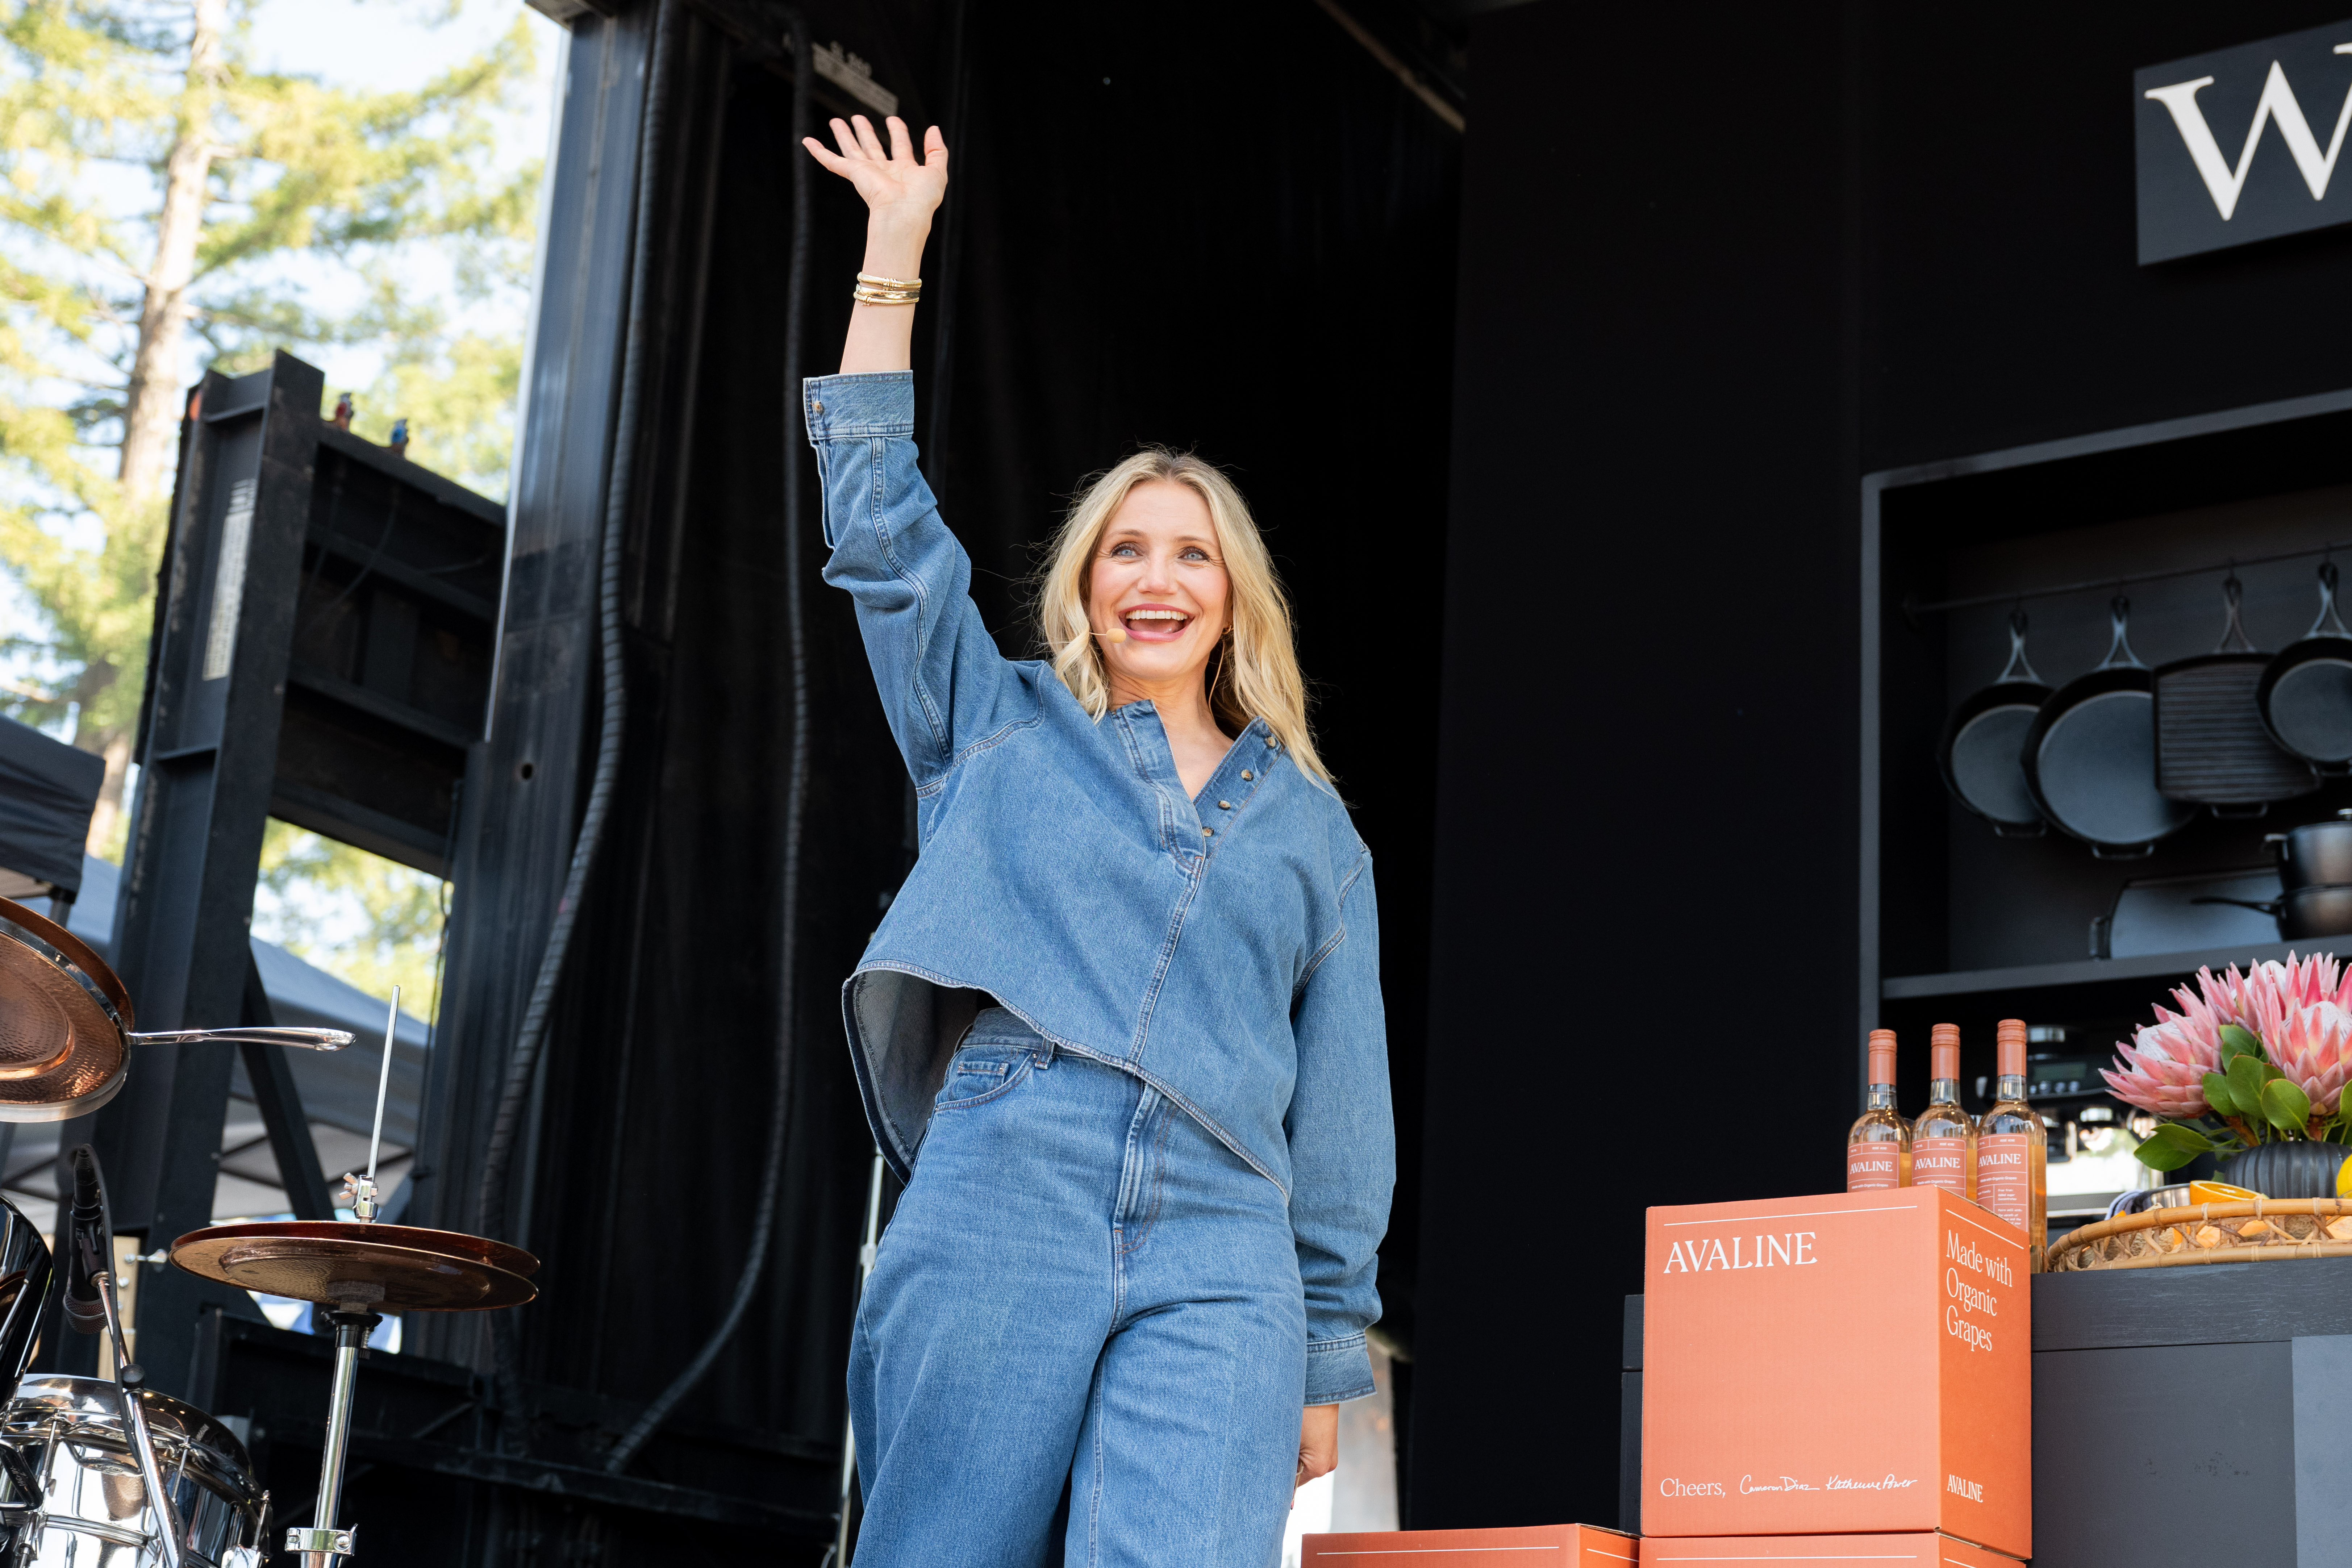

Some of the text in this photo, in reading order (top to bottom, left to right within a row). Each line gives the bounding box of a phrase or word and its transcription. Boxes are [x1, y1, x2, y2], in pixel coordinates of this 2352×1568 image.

[1850, 1161, 1893, 1174] AVALINE
[1915, 1157, 1960, 1170] AVALINE
[1978, 1153, 2022, 1167] AVALINE
[1663, 1232, 1818, 1273] AVALINE
[1946, 1230, 2012, 1287] Made with
[1947, 1268, 1997, 1316] Organic
[1947, 1305, 1992, 1351] Grapes
[1660, 1478, 1726, 1498] Cheers,
[1740, 1475, 1782, 1494] Cameron
[1779, 1476, 1820, 1492] Diaz
[1882, 1474, 1918, 1489] Power
[1947, 1474, 1983, 1503] AVALINE
